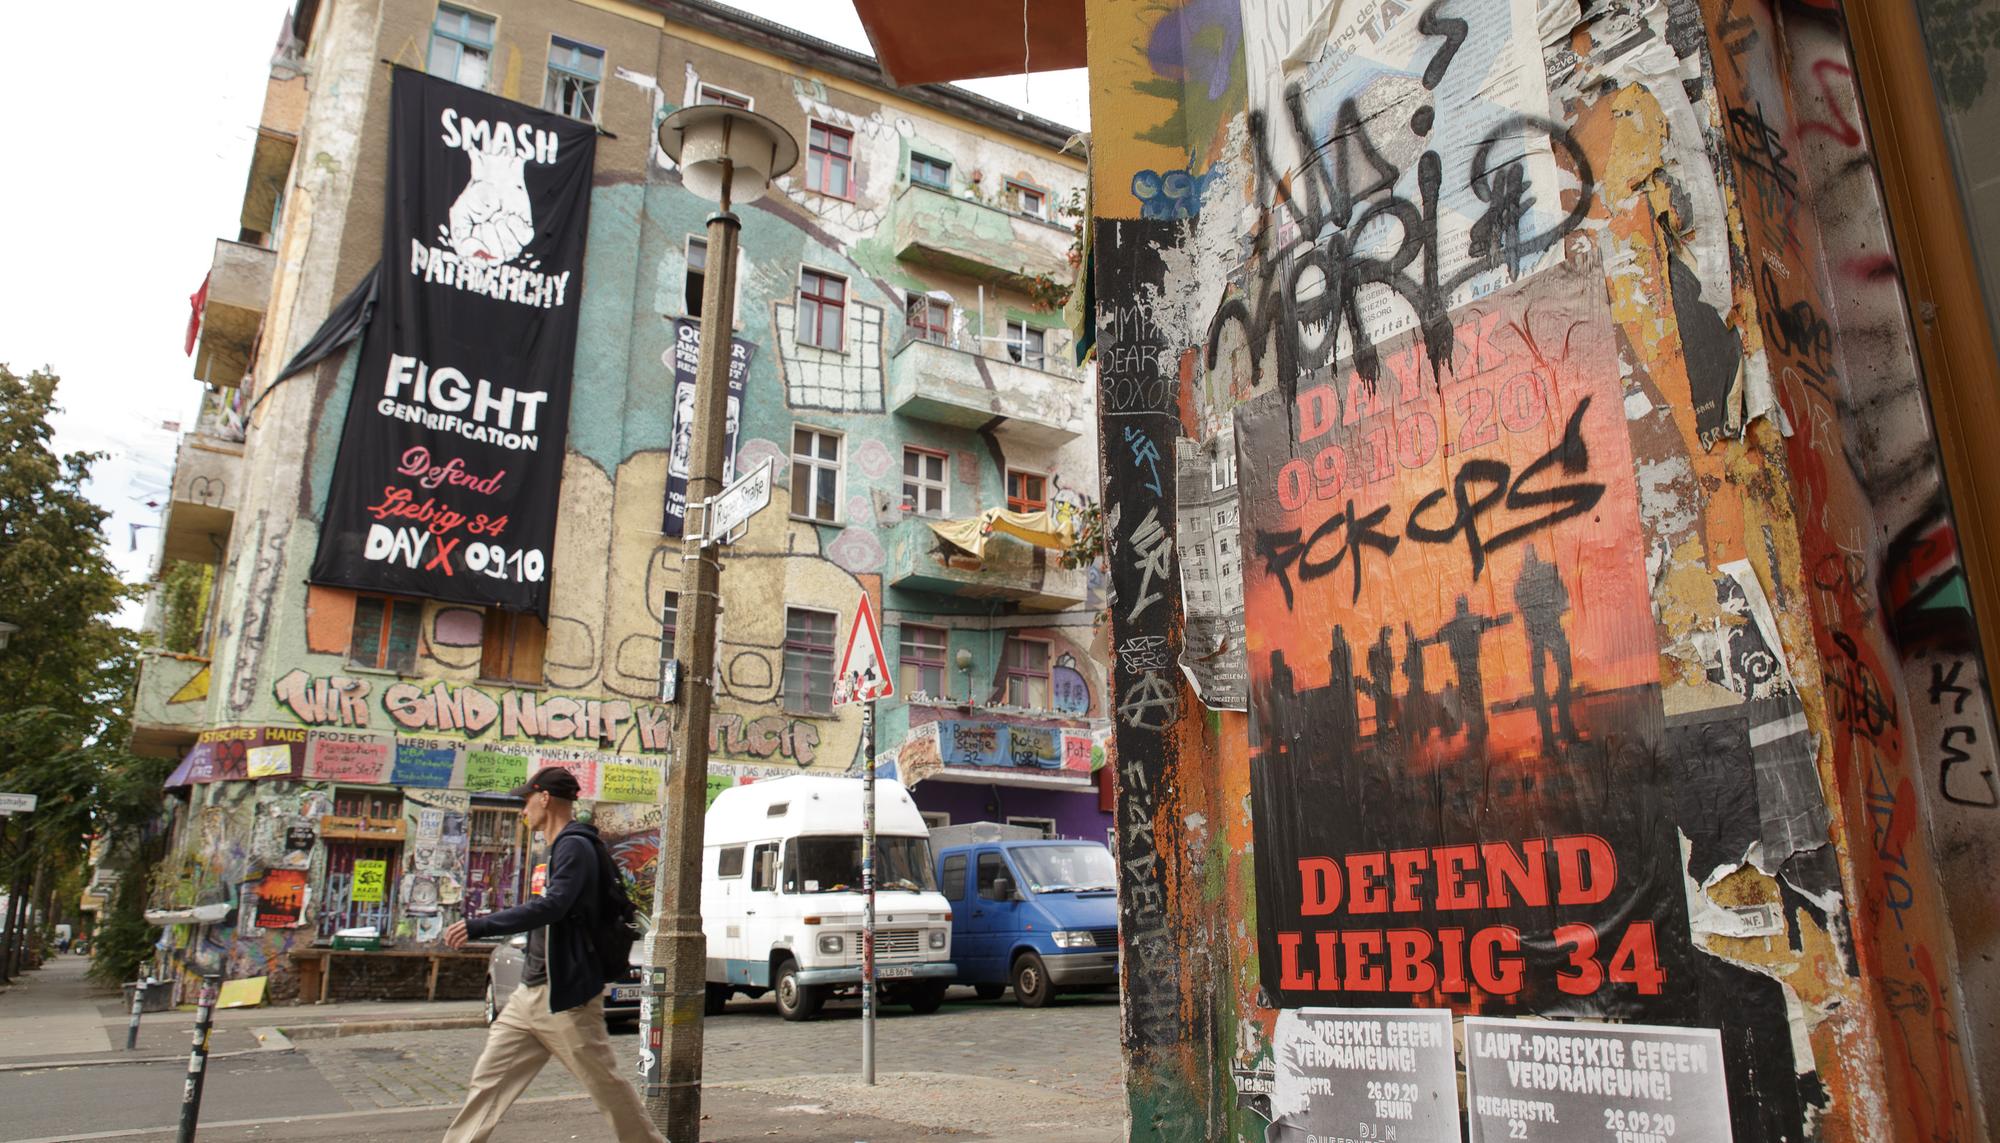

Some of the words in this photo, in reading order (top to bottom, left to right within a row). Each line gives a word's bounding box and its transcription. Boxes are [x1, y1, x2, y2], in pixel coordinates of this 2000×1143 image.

[441, 107, 559, 164] SMASH
[383, 353, 548, 432] FIGHT
[1297, 342, 1430, 443] DAY
[1454, 311, 1507, 385] X
[377, 398, 538, 451] GENTRIFICATION
[1277, 370, 1550, 512] 09.10.20
[397, 446, 506, 495] Defend
[367, 486, 467, 535] Liebig
[467, 513, 510, 537] 34
[364, 523, 432, 570] DAY
[425, 536, 460, 576] X
[265, 728, 306, 743] HAUS
[309, 729, 376, 743] PROJEKT
[396, 738, 439, 750] LIEBIG
[447, 740, 466, 751] 34
[1298, 833, 1618, 917] DEFEND
[1277, 925, 1526, 996] LIEBIG
[1553, 919, 1667, 997] 34
[1387, 1022, 1443, 1048] GEGEN
[1475, 1031, 1625, 1068] LAUT+DRECKIG
[1632, 1040, 1709, 1074] GEGEN
[1366, 1081, 1419, 1103] 26.09.20
[1374, 1100, 1413, 1120] 15UHR
[1476, 1095, 1560, 1124] RIGAERSTR.
[1508, 1119, 1528, 1139] 22
[1603, 1108, 1676, 1137] 26.09.20
